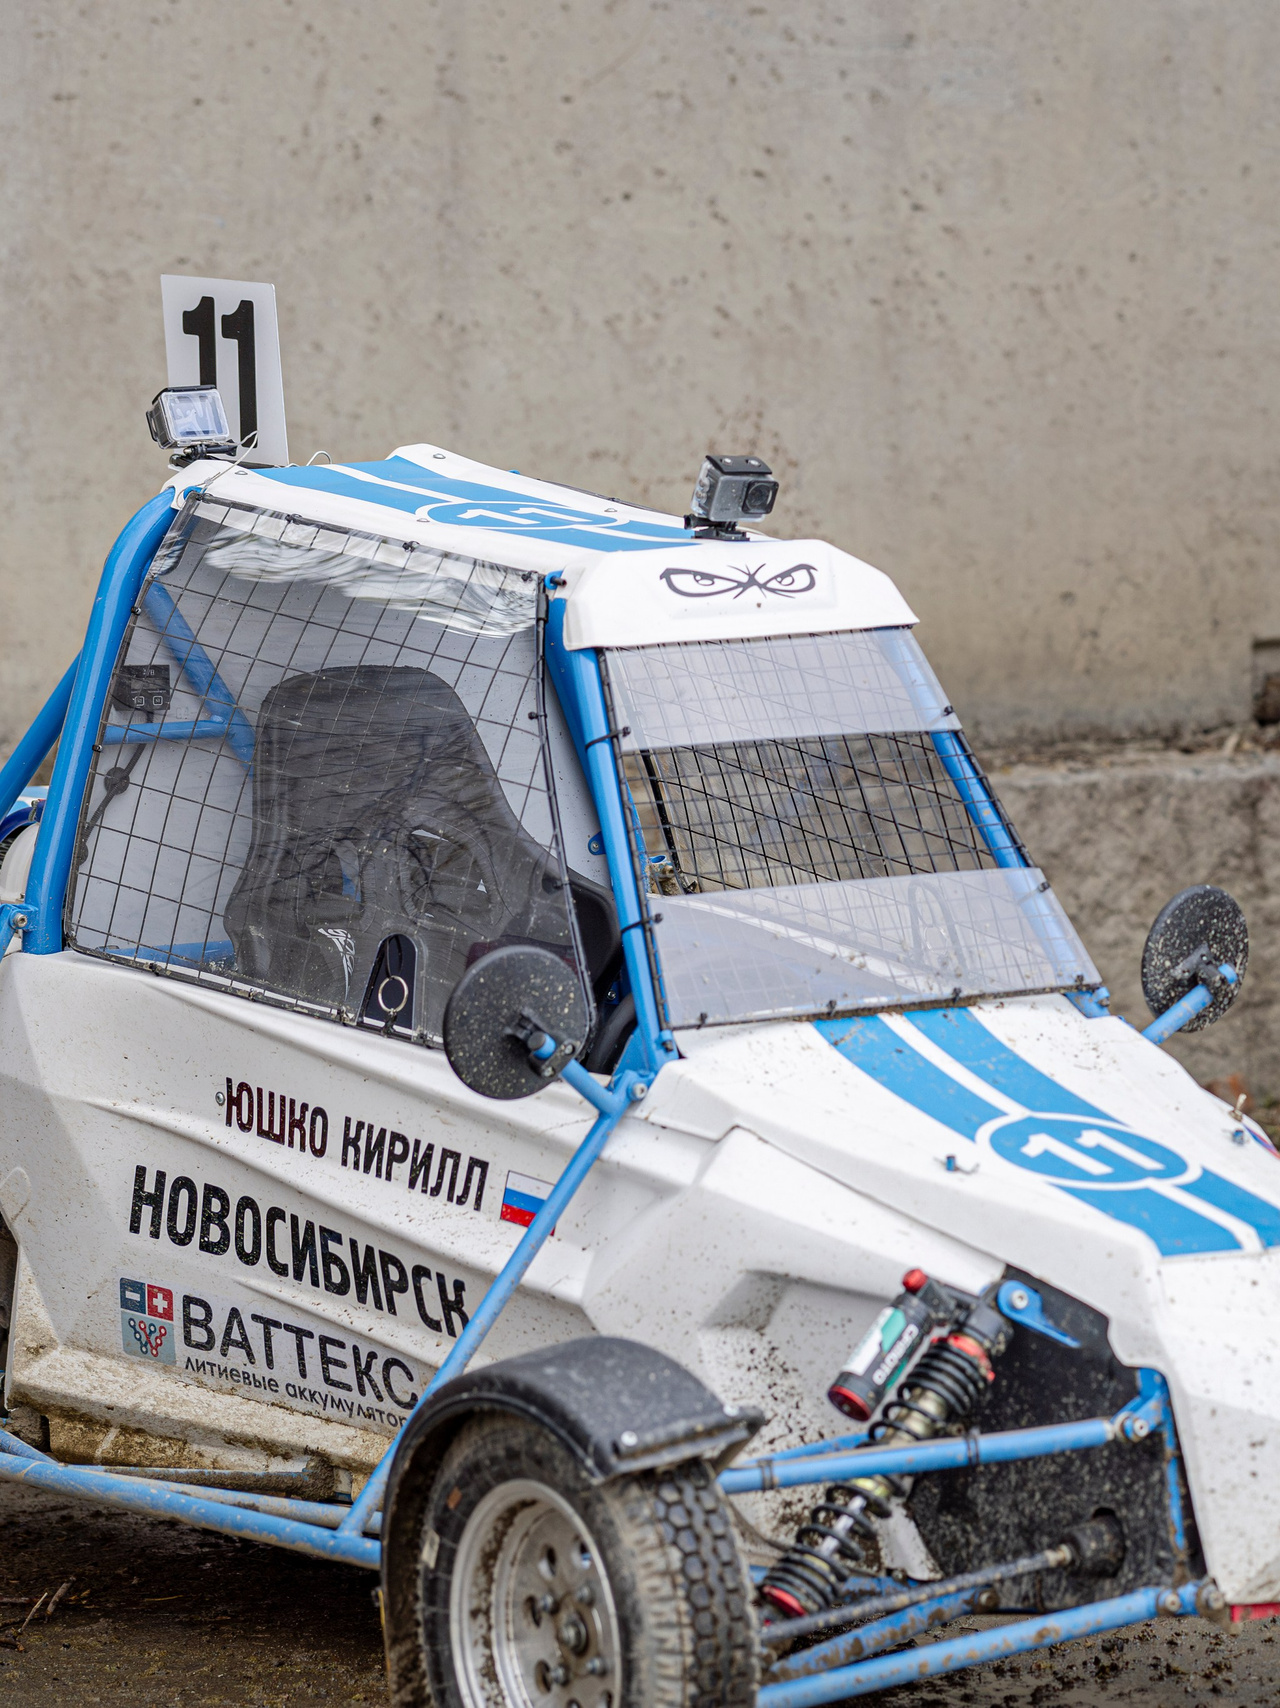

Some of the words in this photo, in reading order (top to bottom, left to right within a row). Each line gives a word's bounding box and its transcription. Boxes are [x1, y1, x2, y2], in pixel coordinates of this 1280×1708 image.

[183, 295, 256, 448] 11
[456, 506, 593, 525] 11
[225, 1077, 328, 1158] ЮШКО
[341, 1116, 489, 1212] КИРИЛЛ
[1020, 1129, 1166, 1176] 11
[129, 1165, 470, 1338] НОВОСИБИРСК
[182, 1295, 419, 1411] ВАТТЕКС
[185, 1356, 280, 1393] литиевые
